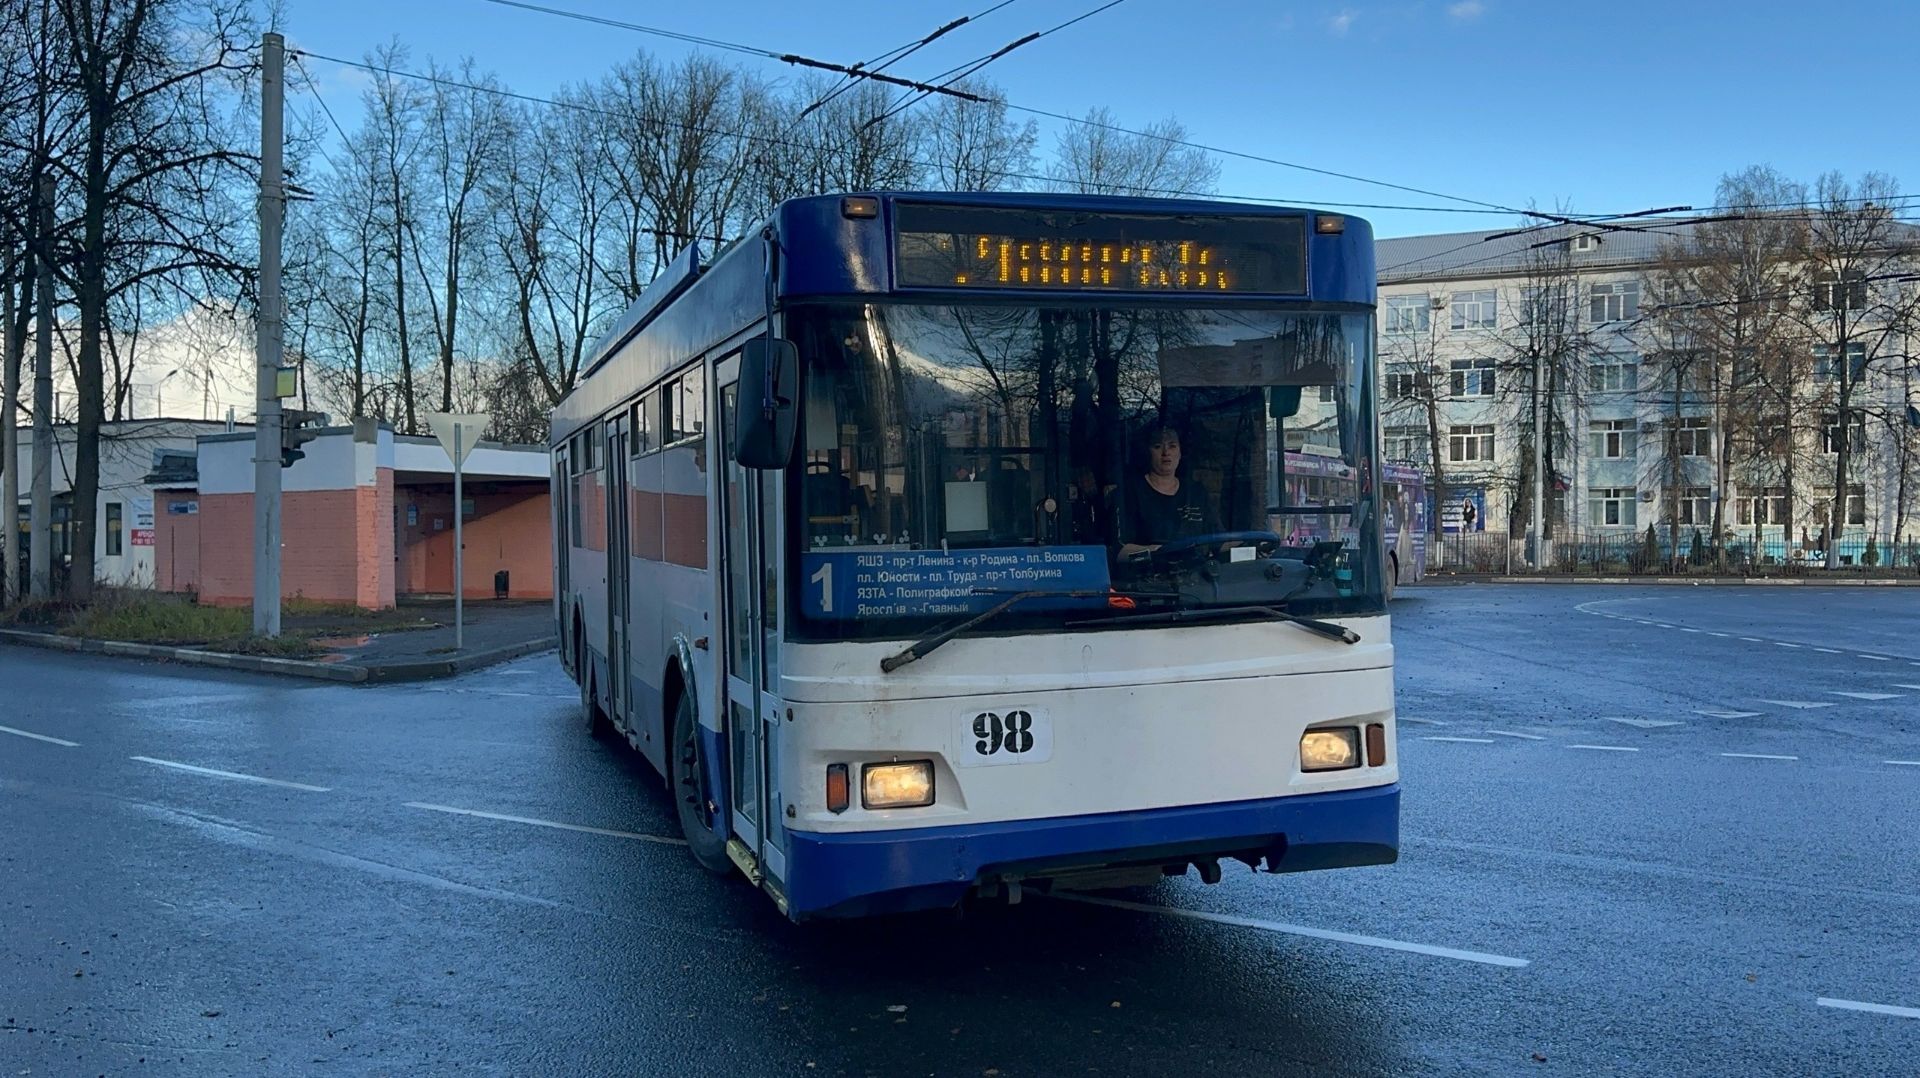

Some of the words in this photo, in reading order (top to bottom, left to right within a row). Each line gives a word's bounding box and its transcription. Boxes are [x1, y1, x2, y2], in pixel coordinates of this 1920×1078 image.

[857, 555, 883, 567] ЯШЗ
[893, 557, 915, 568] пр-т
[918, 555, 954, 566] Ленина
[963, 556, 977, 567] к-р
[980, 554, 1018, 566] Родина
[1026, 555, 1042, 564] пл.
[1044, 552, 1085, 563] Волкова
[857, 574, 874, 582] пл.
[877, 571, 920, 583] Юности
[929, 573, 945, 582] пл.
[947, 570, 977, 583] Труда
[986, 571, 1007, 581] пр-т
[1009, 568, 1062, 581] Толбухина
[811, 562, 832, 612] 1
[857, 588, 887, 599] ЯЗТА
[896, 585, 998, 600] Полиграфкомб
[973, 711, 1034, 755] 98
